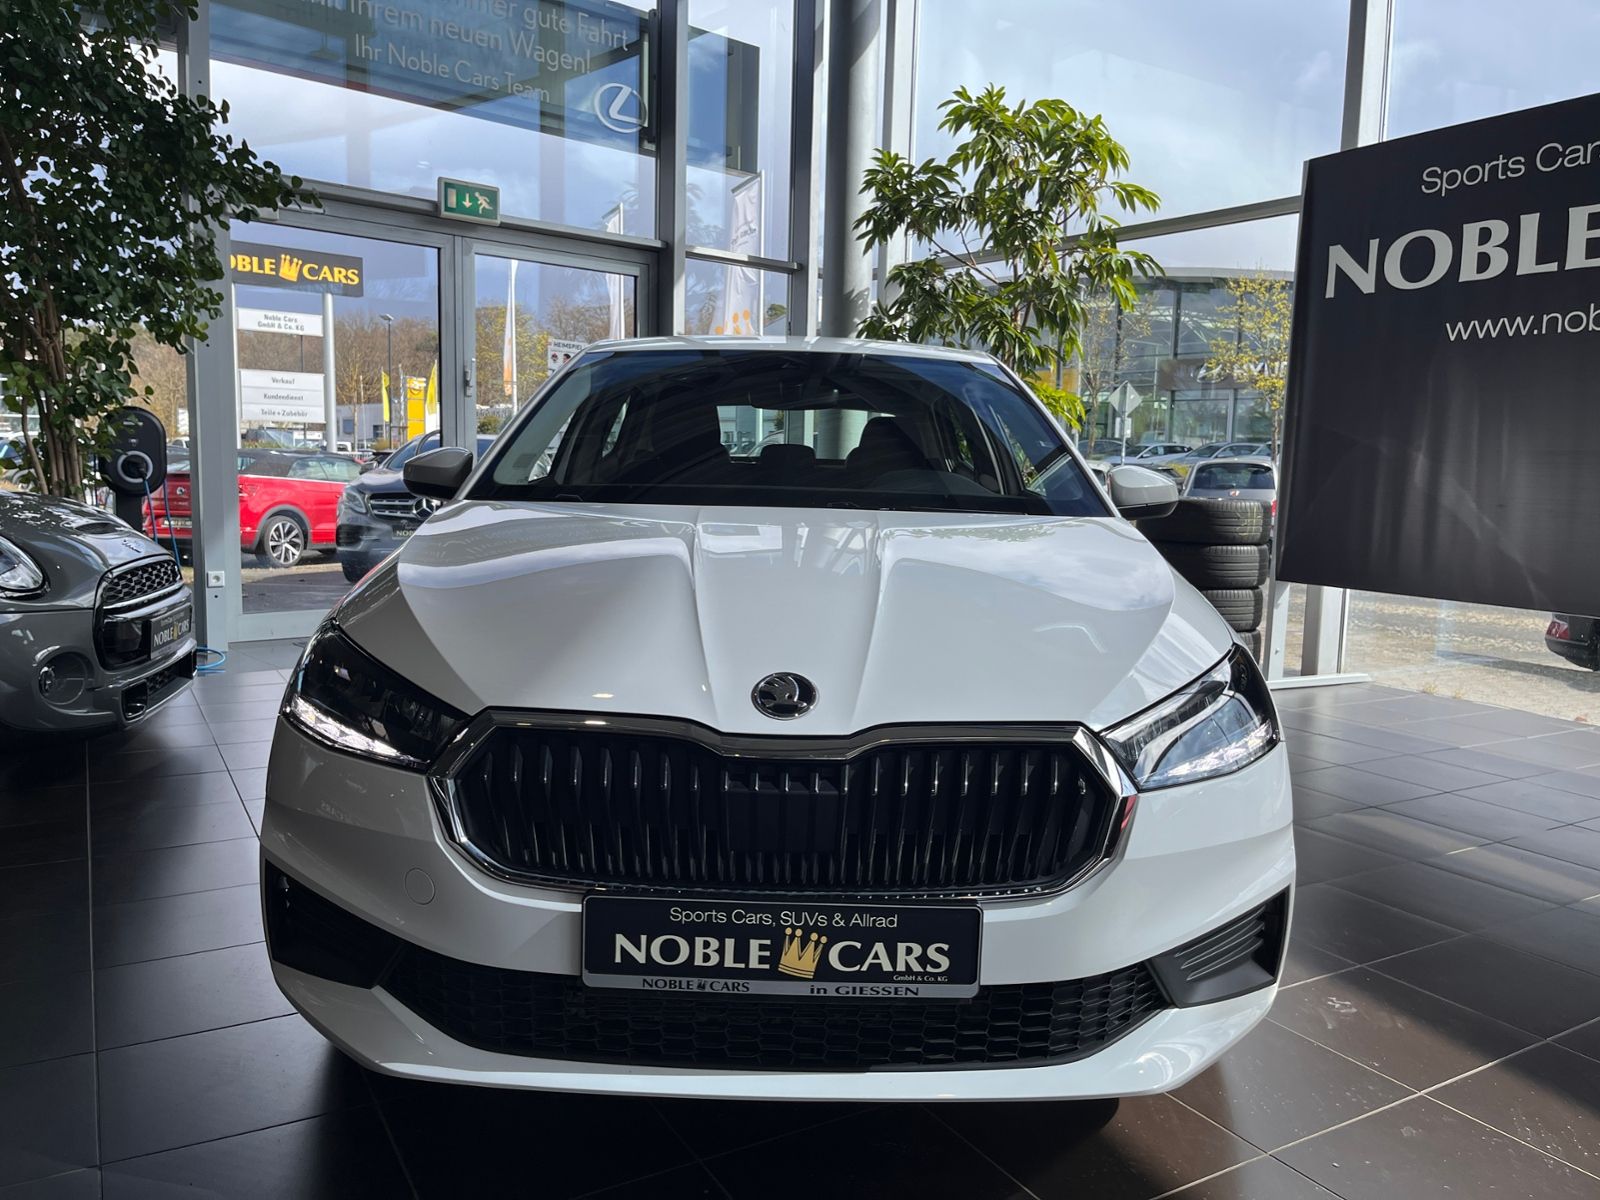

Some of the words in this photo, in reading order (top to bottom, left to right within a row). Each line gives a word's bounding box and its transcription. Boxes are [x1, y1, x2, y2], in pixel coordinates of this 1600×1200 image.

[430, 16, 502, 51] neuen
[524, 7, 571, 34] gute
[578, 11, 628, 52] Fahrt
[356, 33, 381, 61] Ihr
[388, 41, 449, 79] Noble
[455, 59, 499, 91] Cars
[504, 71, 549, 101] Team
[1421, 154, 1525, 197] Sports
[1536, 142, 1600, 172] Car
[1325, 203, 1600, 299] NOBLE
[302, 263, 359, 285] CARS
[264, 313, 281, 321] Noble
[284, 315, 298, 323] Cars
[271, 376, 295, 385] Verkauf
[153, 626, 174, 648] NOBLE
[670, 907, 727, 925] Sports
[731, 909, 776, 927] Cars,
[780, 911, 828, 927] SUVs
[832, 913, 846, 927] &
[849, 913, 898, 928] Allrad
[614, 933, 771, 969] NOBLE
[828, 941, 950, 973] CARS
[642, 978, 694, 990] NOBLE
[709, 980, 750, 993] CARS
[893, 974, 916, 982] GmbH
[810, 985, 828, 995] in
[835, 985, 919, 996] GIESSEN
